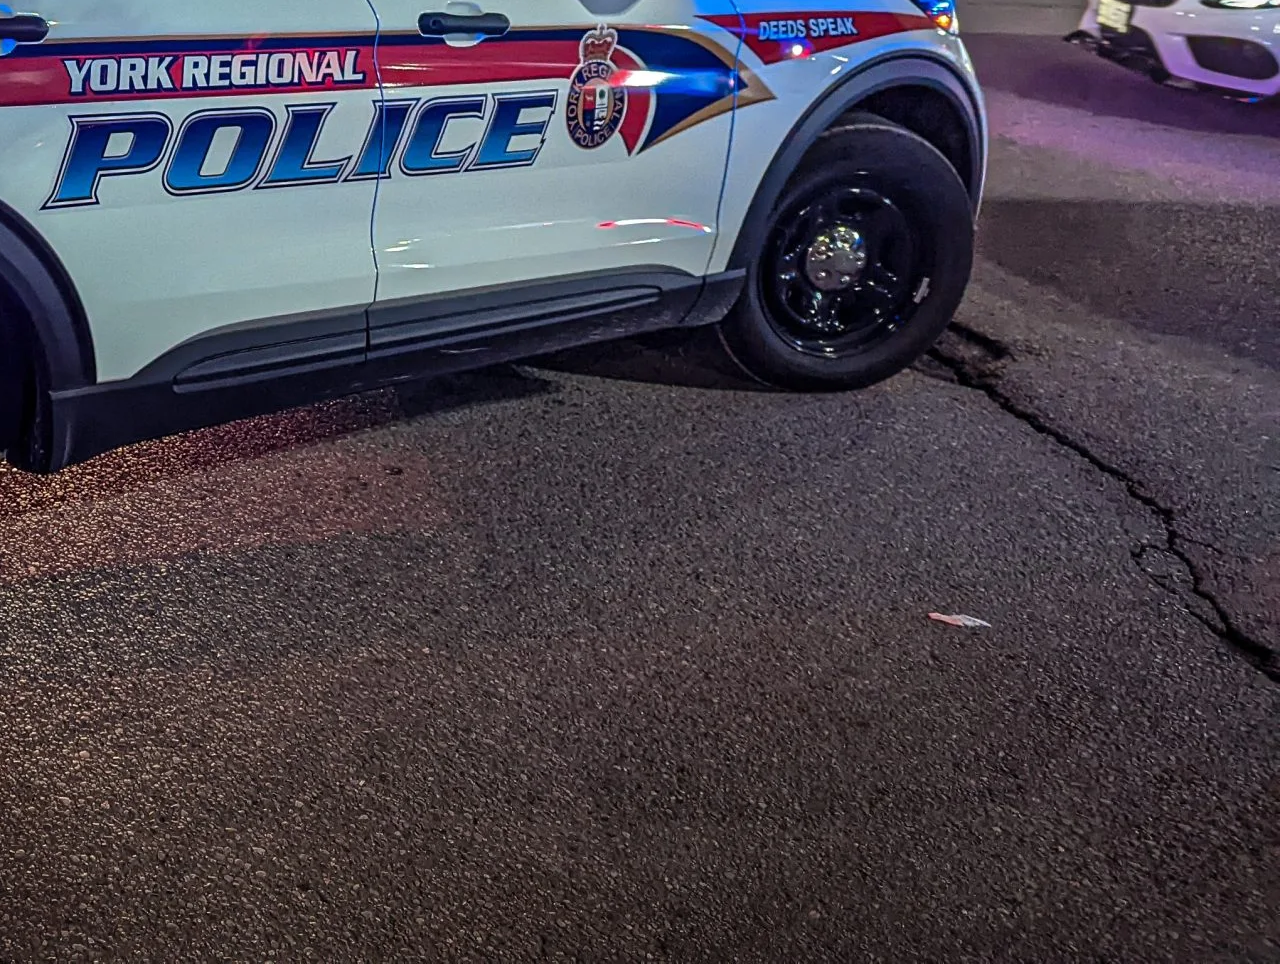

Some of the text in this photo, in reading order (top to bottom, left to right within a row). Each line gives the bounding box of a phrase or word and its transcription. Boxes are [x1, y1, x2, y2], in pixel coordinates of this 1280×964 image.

[758, 17, 858, 40] DEEDS SPEAK
[63, 49, 366, 95] YORK REGIONAL
[568, 78, 584, 131] YORK
[576, 128, 612, 147] POLICE
[39, 89, 558, 211] POLICE
